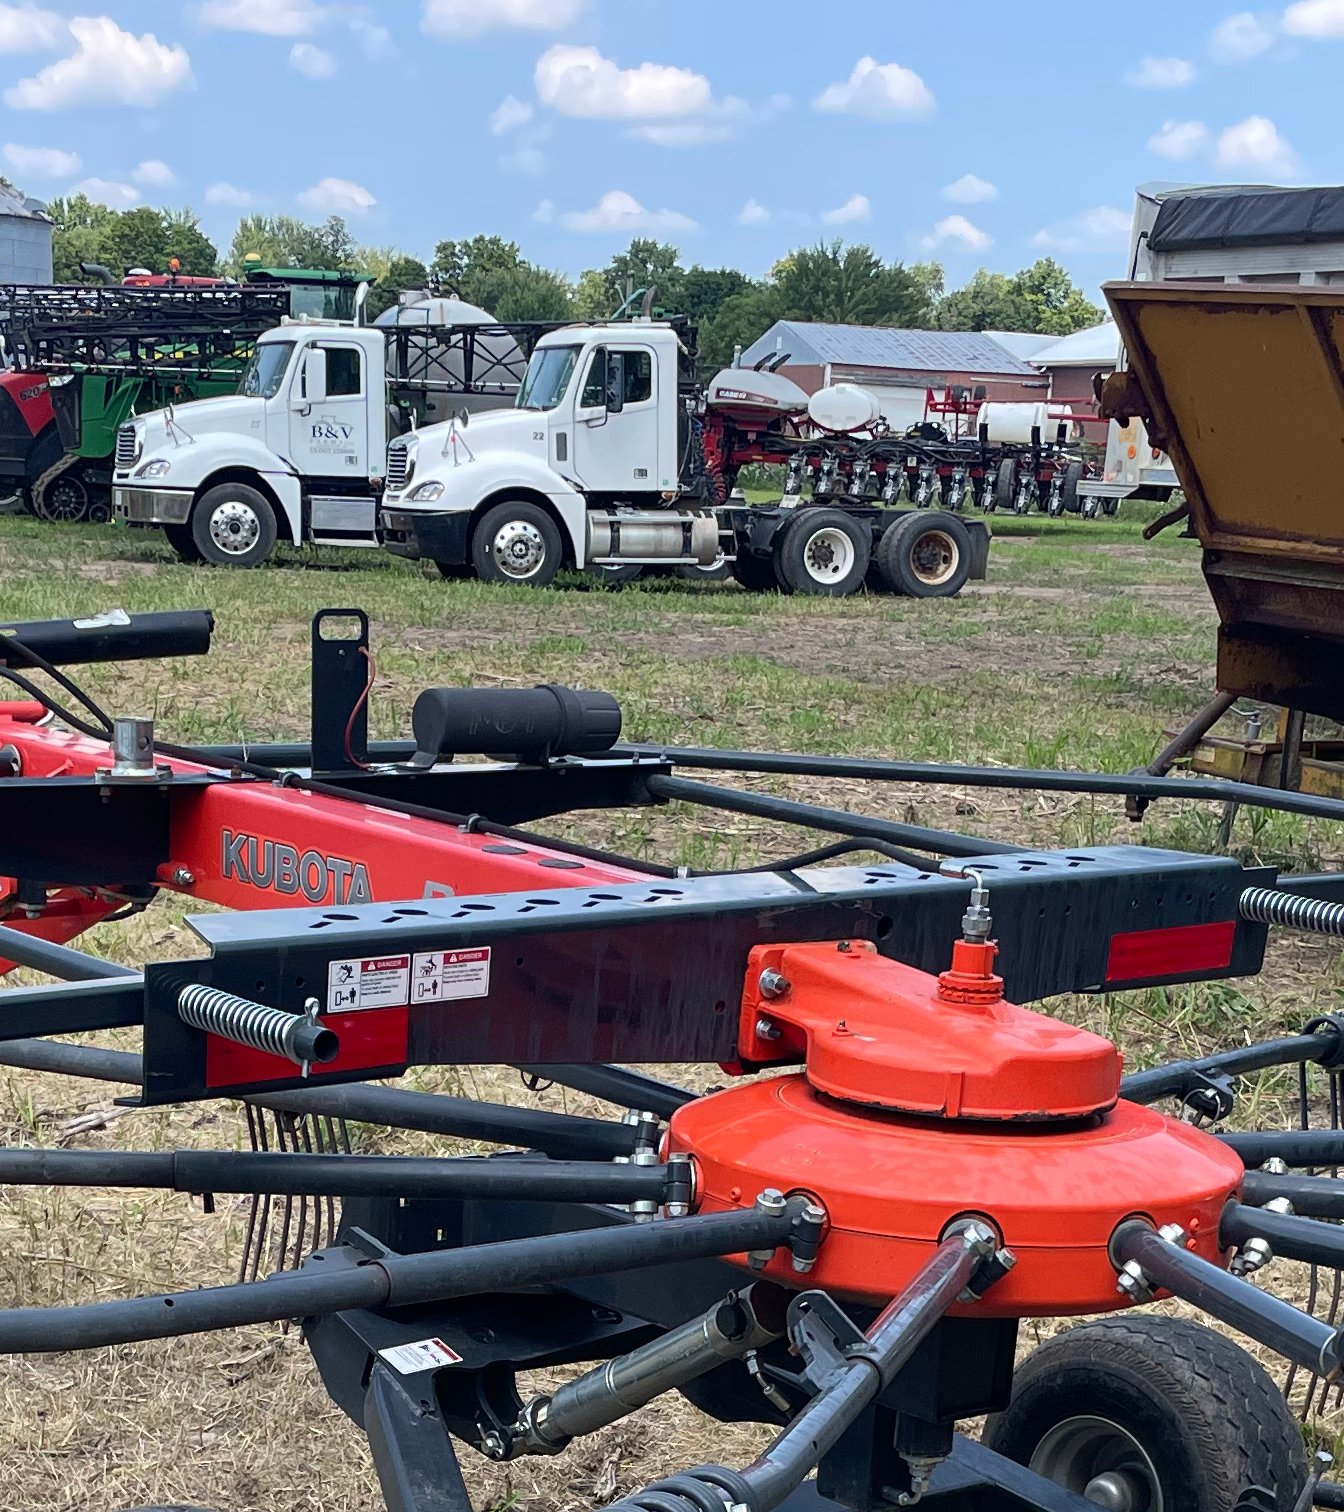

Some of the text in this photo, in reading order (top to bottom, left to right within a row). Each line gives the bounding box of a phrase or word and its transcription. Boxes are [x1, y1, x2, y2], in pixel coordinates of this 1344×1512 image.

[312, 425, 354, 439] B&V
[532, 431, 544, 440] 22
[222, 829, 373, 906] KUBOTA
